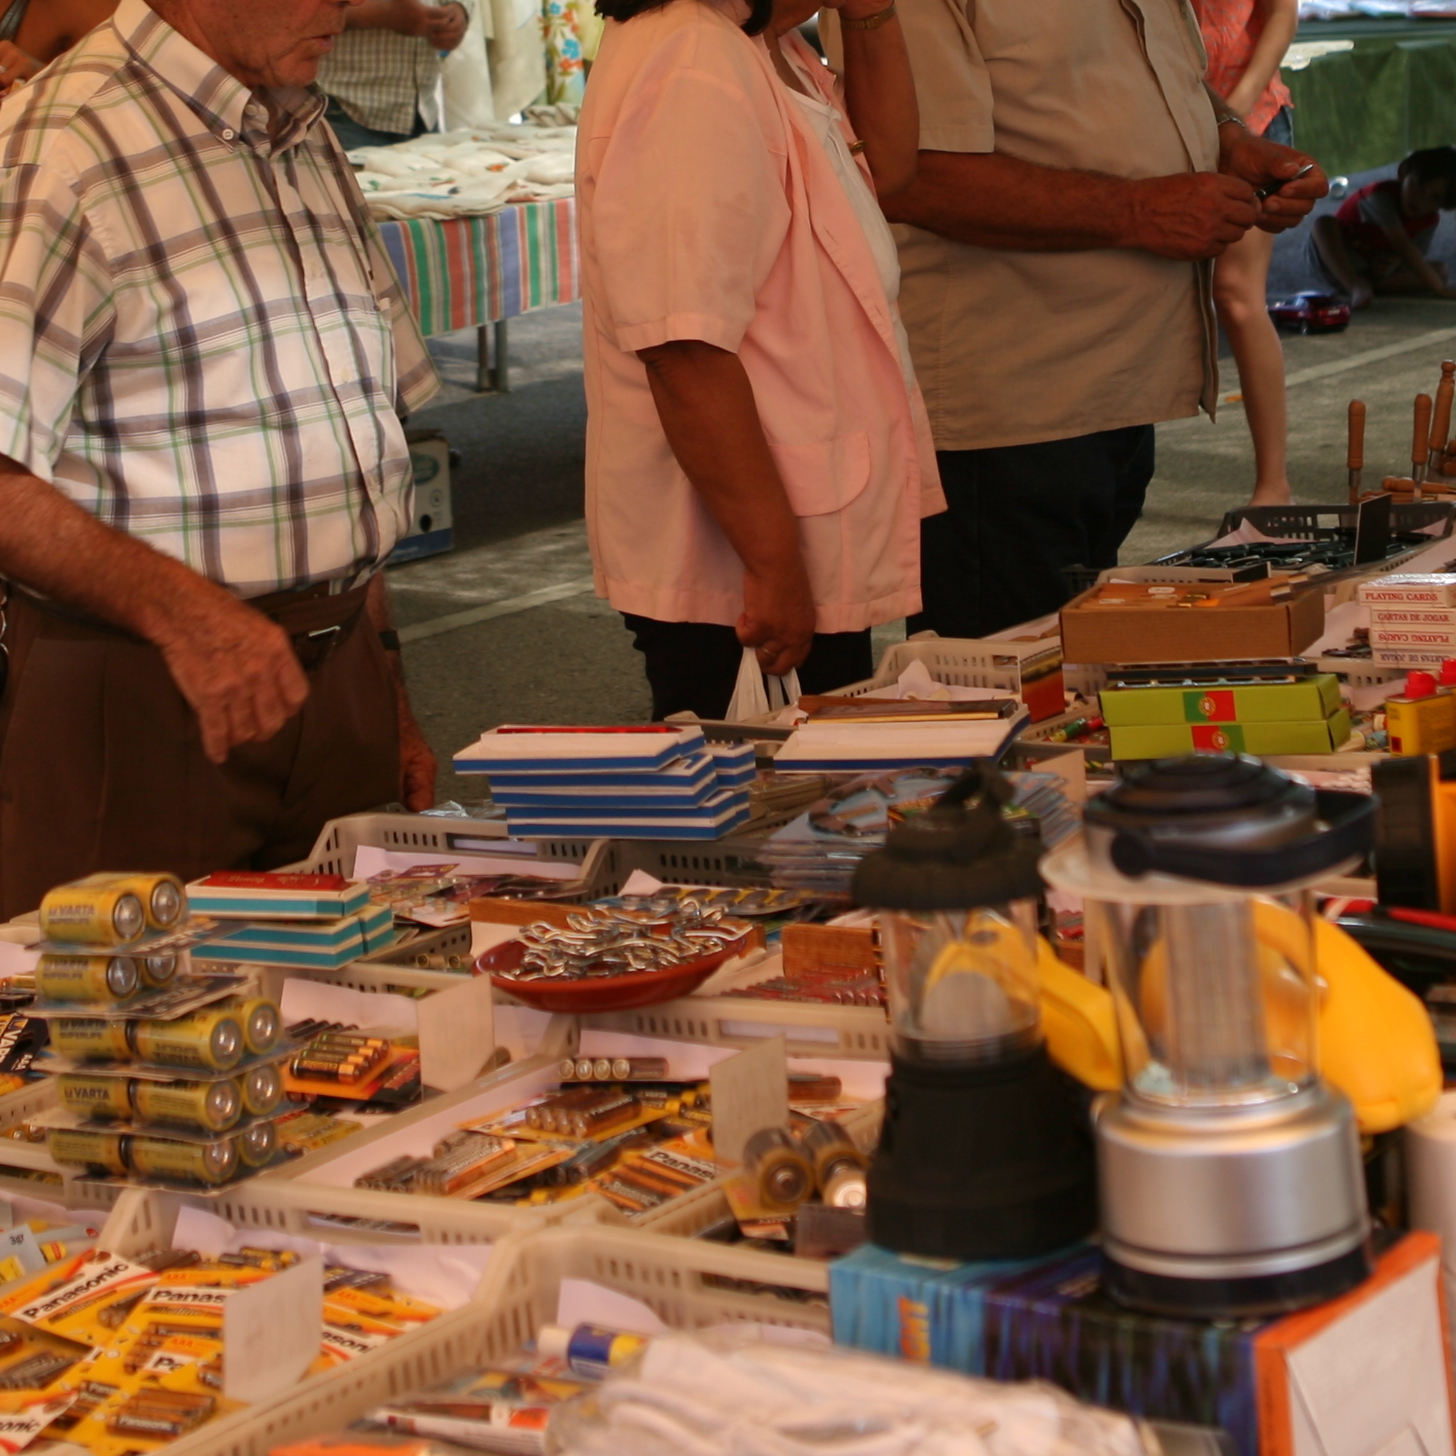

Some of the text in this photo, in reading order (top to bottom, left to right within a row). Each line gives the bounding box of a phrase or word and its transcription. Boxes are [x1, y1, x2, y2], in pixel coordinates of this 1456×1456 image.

[1365, 592, 1439, 602] PLAYING CARDS
[1377, 613, 1451, 623] CARTAS DE JOGAR
[1411, 633, 1451, 644] PLAYING
[59, 904, 95, 918] VARTA
[74, 1086, 111, 1101] VARTA
[22, 1259, 131, 1321] Panasonic
